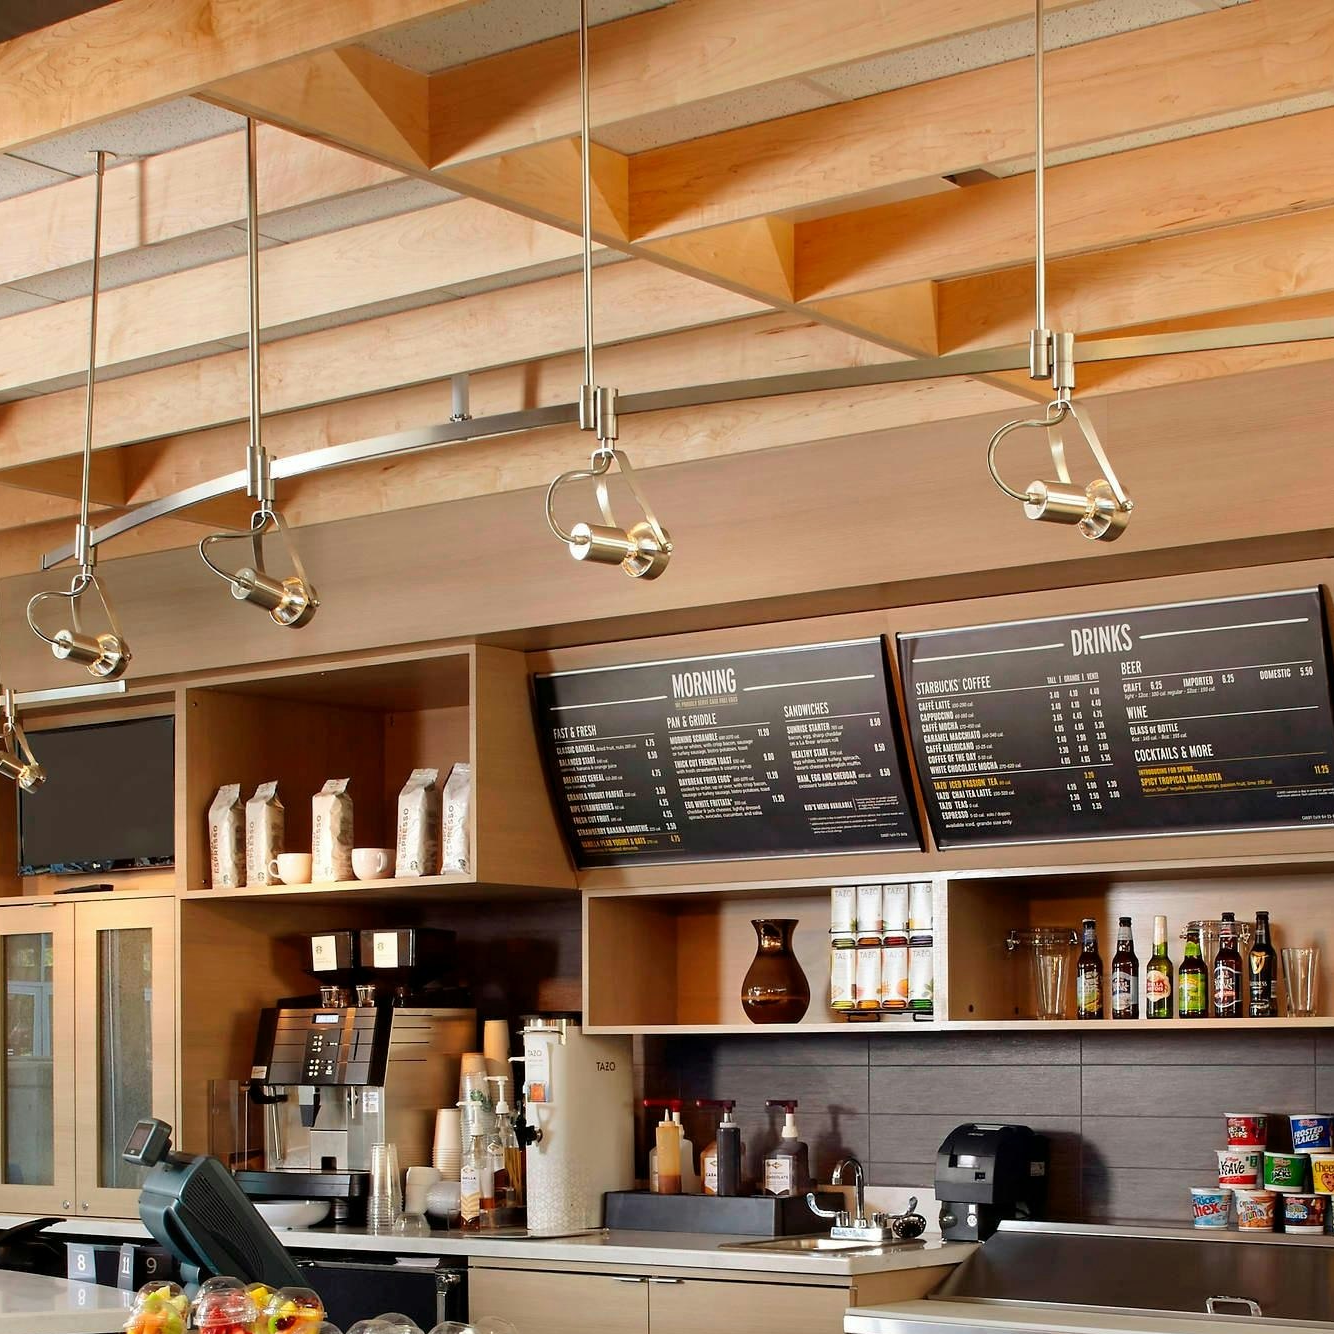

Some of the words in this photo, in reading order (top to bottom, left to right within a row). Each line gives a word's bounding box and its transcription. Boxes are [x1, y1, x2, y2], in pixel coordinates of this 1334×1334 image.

[1071, 623, 1132, 656] DRINKS
[1121, 661, 1142, 674] BEER
[1260, 669, 1291, 680] DOMESTIC
[1300, 666, 1313, 676] 5.50
[672, 668, 736, 698] MORNING
[963, 676, 991, 690] COFFEE
[1123, 683, 1141, 692] CRAFT
[1151, 680, 1162, 690] 6.25
[1183, 676, 1213, 687] IMPORTED
[1222, 674, 1234, 684] 6.25
[784, 703, 828, 718] SANDWICHES
[935, 700, 950, 710] LATTE
[1126, 706, 1148, 719] WINE
[667, 717, 680, 728] PAN
[682, 716, 687, 726] &
[689, 713, 716, 725] GRIDDLE
[553, 728, 568, 740] FAST
[570, 727, 575, 737] &
[577, 725, 596, 736] FRESH
[809, 723, 830, 732] STARTER
[1130, 725, 1148, 735] GLASS
[1157, 723, 1179, 733] BOTTLE
[814, 748, 828, 757] START
[1134, 746, 1179, 762] COCKTAILS
[1182, 746, 1187, 758] &
[1190, 744, 1213, 758] MORE
[1314, 765, 1329, 774] 11.25
[1141, 777, 1157, 786] SPICY
[1159, 775, 1186, 785] TROPICAL
[1188, 773, 1222, 783] MARGARITA
[596, 1062, 616, 1071] TAZO
[1294, 1126, 1323, 1139] FROSTED
[77, 1254, 86, 1271] 8
[122, 1257, 130, 1274] 11
[146, 1257, 157, 1274] 9
